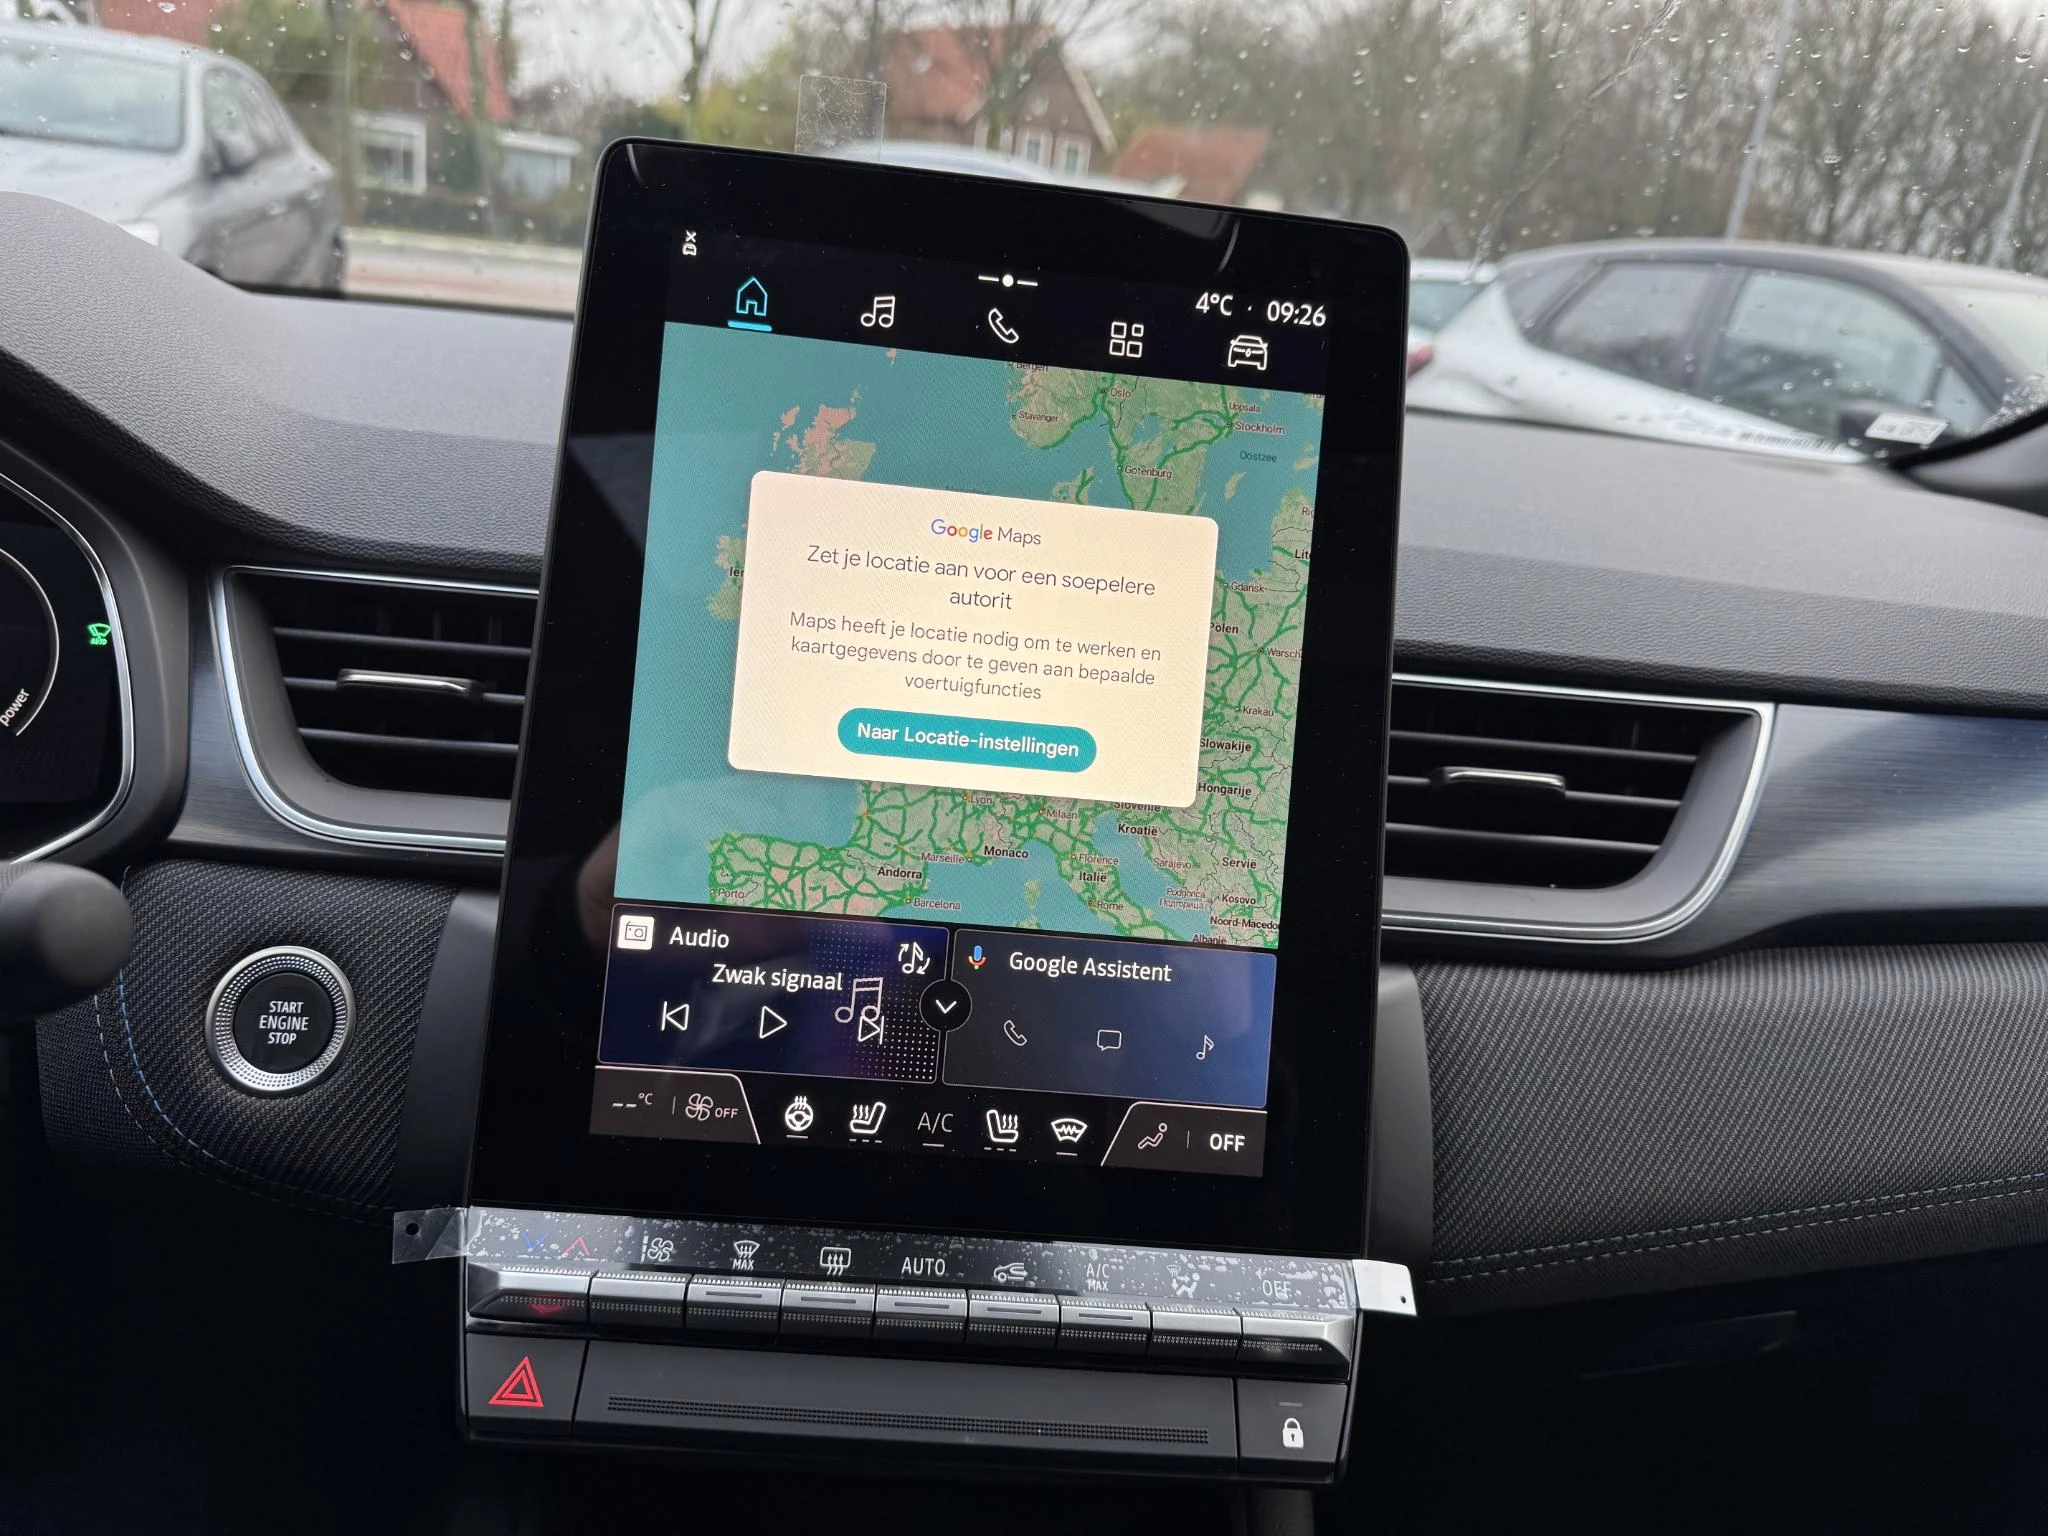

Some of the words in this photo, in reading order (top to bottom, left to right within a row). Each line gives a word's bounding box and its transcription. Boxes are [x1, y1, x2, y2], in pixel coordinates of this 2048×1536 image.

[1195, 291, 1234, 316] 4°C
[1267, 299, 1327, 327] 09:26
[1110, 387, 1132, 399] Oslo
[1229, 402, 1261, 413] Uppsala
[1018, 410, 1058, 423] Stavanger
[1235, 421, 1285, 434] Stockholm
[1239, 450, 1278, 463] Oostzee
[1124, 464, 1172, 479] Gotenburg
[931, 518, 993, 543] Google
[997, 526, 1042, 547] Maps
[807, 544, 839, 564] Zet
[842, 548, 861, 570] je
[866, 550, 930, 574] locatie
[935, 562, 968, 578] aan
[973, 566, 1017, 582] voor
[1021, 570, 1057, 586] een
[1061, 575, 1156, 596] soepelere
[949, 591, 1013, 610] autorit
[790, 611, 836, 633] Maps
[841, 615, 886, 635] heeft
[889, 620, 905, 640] je
[910, 622, 968, 643] locatie
[973, 630, 1019, 652] nodig
[1024, 637, 1050, 651] om
[1056, 637, 1072, 653] te
[1077, 641, 1136, 659] werken
[1141, 648, 1161, 661] en
[791, 636, 917, 663] kaartgegevens
[922, 649, 962, 667] door
[967, 653, 983, 669] te
[988, 659, 1038, 675] geven
[1043, 664, 1073, 678] aan
[1078, 663, 1155, 685] bepaalde
[905, 675, 1042, 700] voertuigfuncties
[0, 688, 30, 727] power
[1243, 705, 1274, 717] Krakau
[857, 722, 899, 741] Naar
[904, 726, 1080, 759] Locatie-instellingen
[1200, 738, 1252, 753] Slowakije
[1198, 783, 1252, 797] Hongarije
[970, 796, 993, 806] Lyon
[1046, 809, 1077, 820] Milaan
[1118, 823, 1158, 836] Kroatië
[921, 852, 965, 865] Marseille
[984, 845, 1029, 859] Monaco
[1079, 853, 1119, 865] Florence
[1153, 857, 1192, 870] Sarajevo
[1222, 856, 1257, 869] Servië
[877, 866, 922, 879] Andorra
[1079, 870, 1107, 883] Italië
[718, 888, 745, 899] Porto
[1222, 893, 1257, 905] Kosovo
[914, 898, 961, 910] Barcelona
[1097, 901, 1124, 911] Rome
[669, 926, 729, 948] Audio
[1009, 951, 1078, 978] Google
[1083, 957, 1173, 982] Assistent
[712, 963, 767, 986] Zwak
[771, 968, 843, 992] signaal
[269, 1000, 304, 1014] START
[259, 1015, 310, 1031] ENGINE
[267, 1031, 297, 1045] STOP
[714, 1106, 739, 1119] OFF
[917, 1111, 954, 1134] A/C
[1209, 1133, 1246, 1152] OFF
[732, 1258, 755, 1271] MAX
[901, 1256, 947, 1276] AUTO
[1086, 1262, 1110, 1279] A/C
[1086, 1278, 1109, 1292] MAX
[1262, 1279, 1292, 1297] OFF
